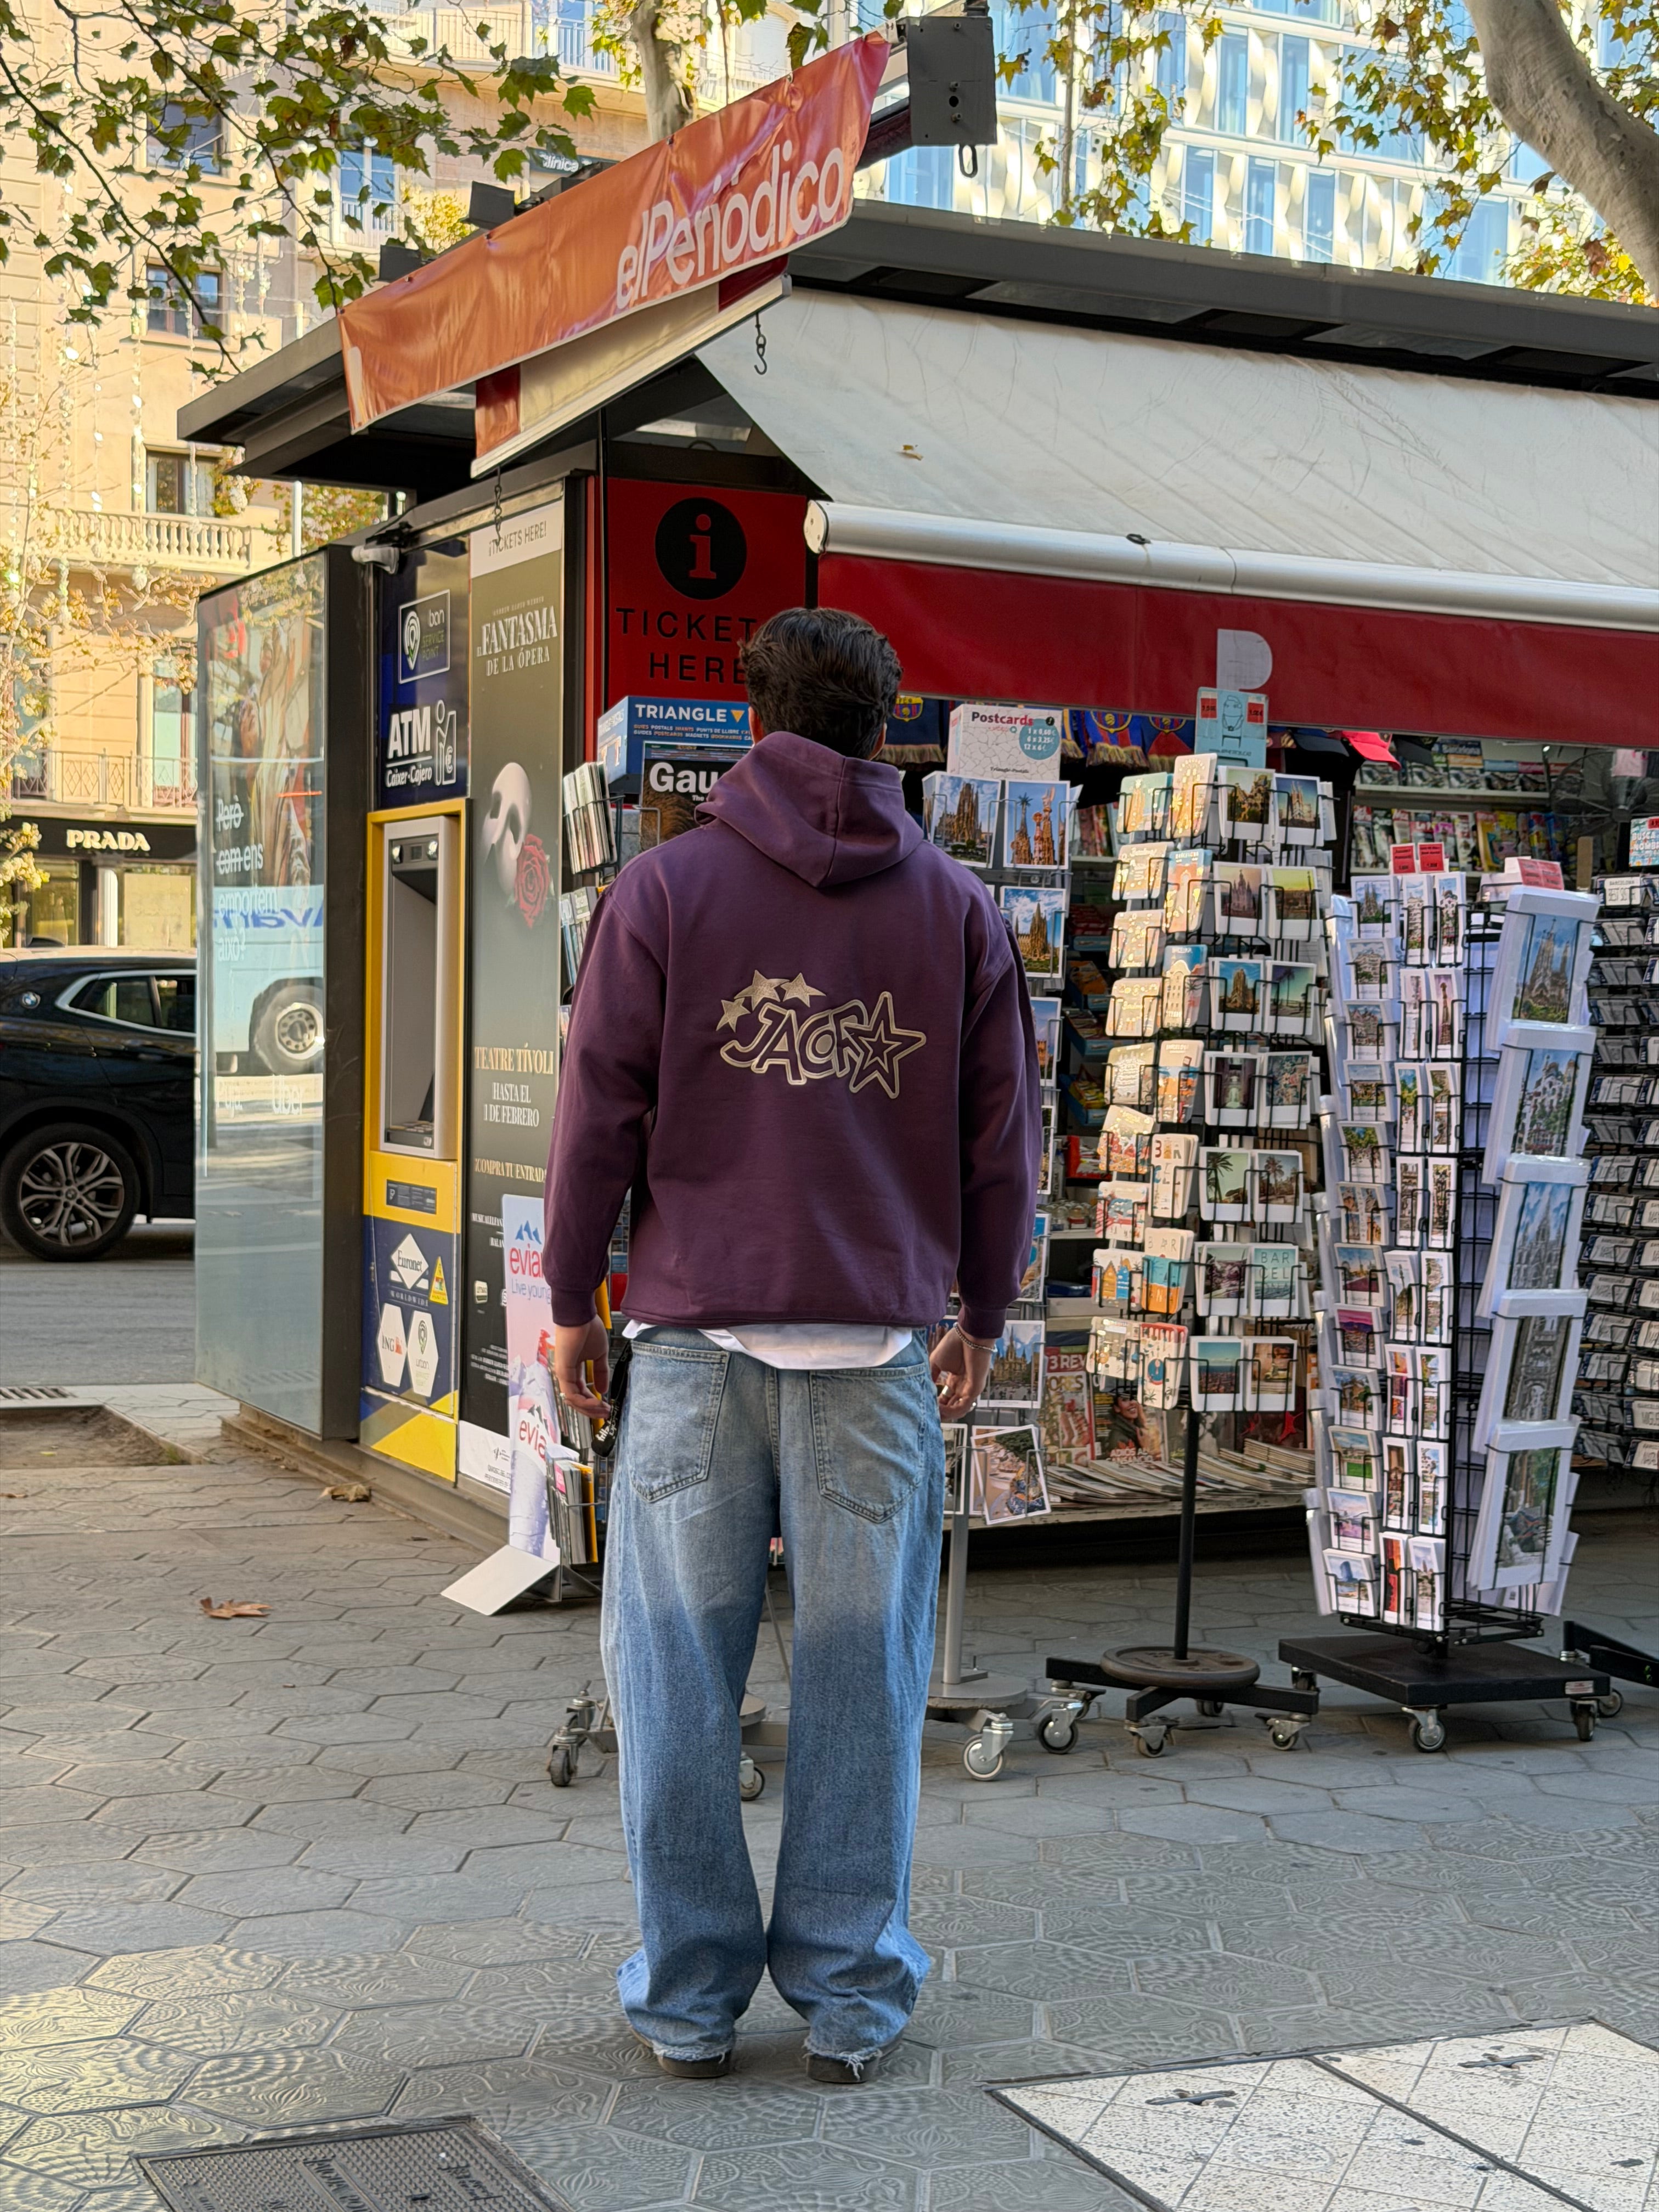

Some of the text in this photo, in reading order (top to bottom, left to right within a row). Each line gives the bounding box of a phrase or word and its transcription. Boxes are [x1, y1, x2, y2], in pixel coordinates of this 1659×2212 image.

[616, 139, 845, 311] elPeriódico
[524, 521, 547, 544] HERE!
[428, 608, 445, 628] ban
[616, 607, 757, 642] TICKET
[482, 606, 557, 656] FANTASMA
[486, 645, 550, 676] DE LA ÓPERA
[635, 704, 727, 723] TRIANGLE
[972, 711, 1034, 726] Postcards
[387, 706, 431, 759] ATM
[650, 761, 718, 793] Gau
[66, 829, 151, 851] PRADA
[244, 843, 263, 872] ens
[475, 1042, 554, 1075] TEATRE TÍVOLI
[492, 1082, 532, 1103] HASTA EL
[483, 1104, 540, 1127] 1 DE FEBRERO
[505, 1162, 515, 1177] TU
[397, 1249, 423, 1273] Euronet
[1261, 1251, 1289, 1264] BAR
[1259, 1267, 1289, 1279] CEL
[511, 1278, 527, 1295] Live
[390, 1290, 428, 1308] WORLDWIDE
[381, 1335, 395, 1352] ING
[1049, 1354, 1086, 1370] 3 REV
[1045, 1375, 1084, 1392] ORES
[518, 1419, 548, 1461] evia
